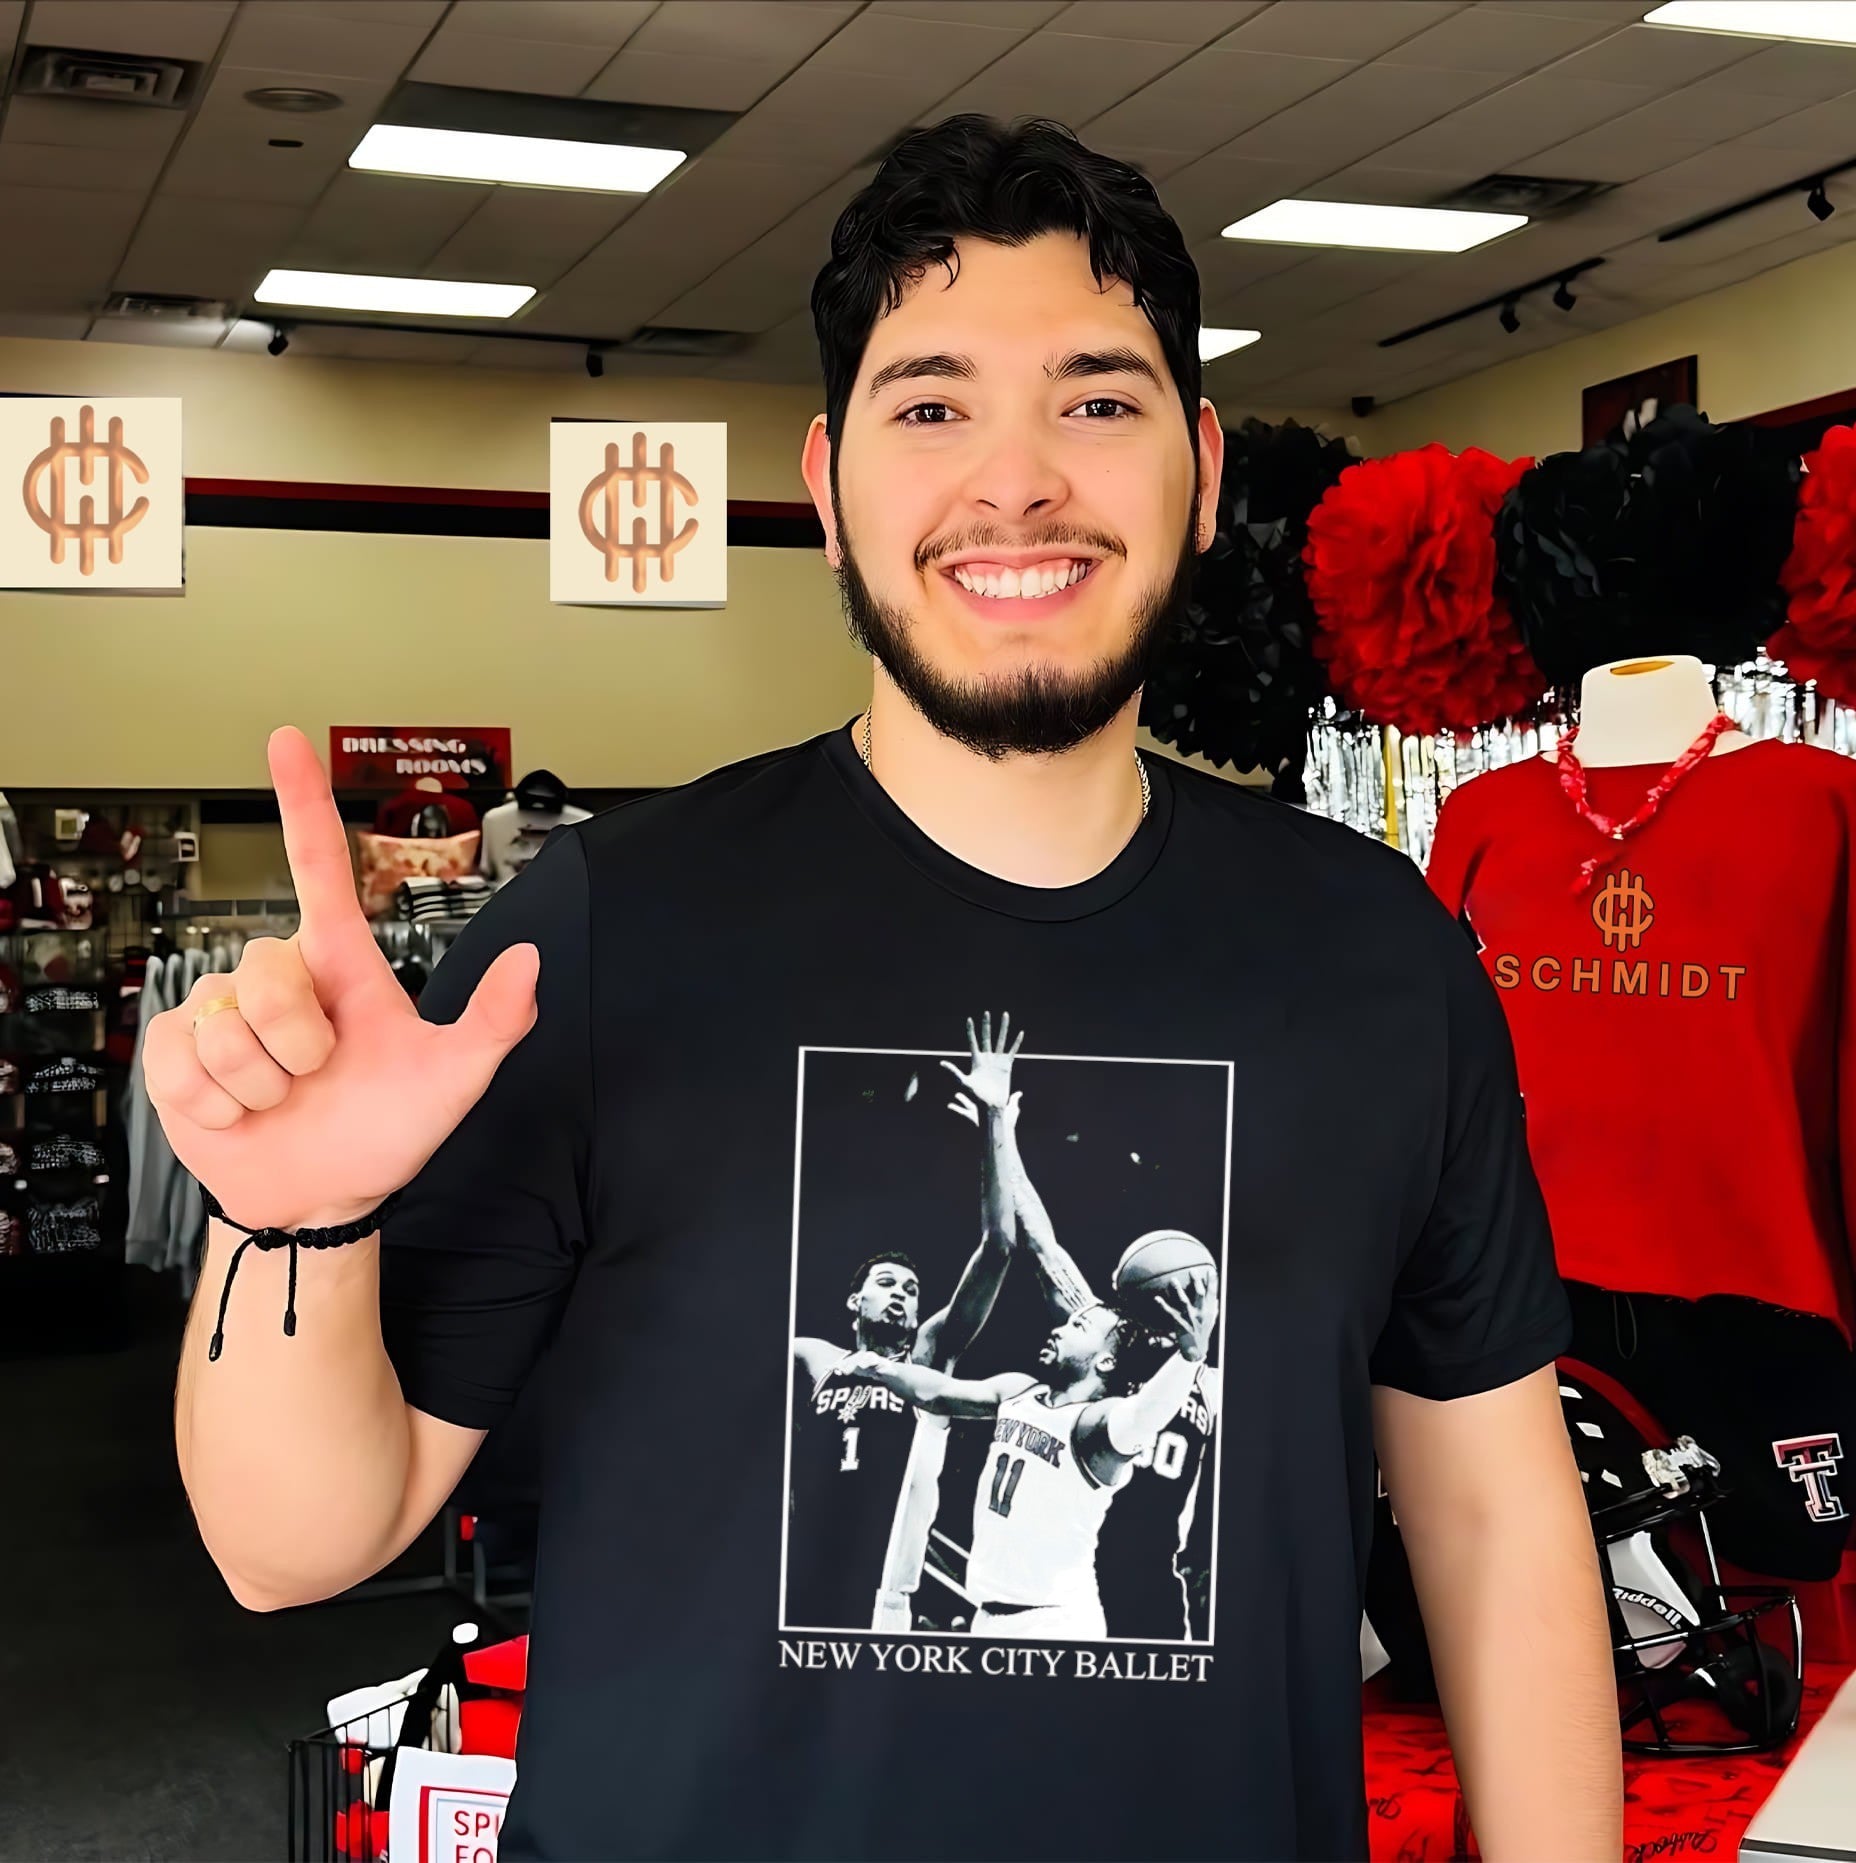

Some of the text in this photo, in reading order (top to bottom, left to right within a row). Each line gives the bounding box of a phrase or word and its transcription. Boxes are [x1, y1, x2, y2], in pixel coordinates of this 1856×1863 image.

[1494, 954, 1747, 1000] SCHMIDT
[840, 1427, 860, 1472] 1
[1016, 1422, 1066, 1469] YORK
[988, 1453, 1025, 1519] 11
[778, 1640, 1214, 1682] NEW YORK CITY BALLET
